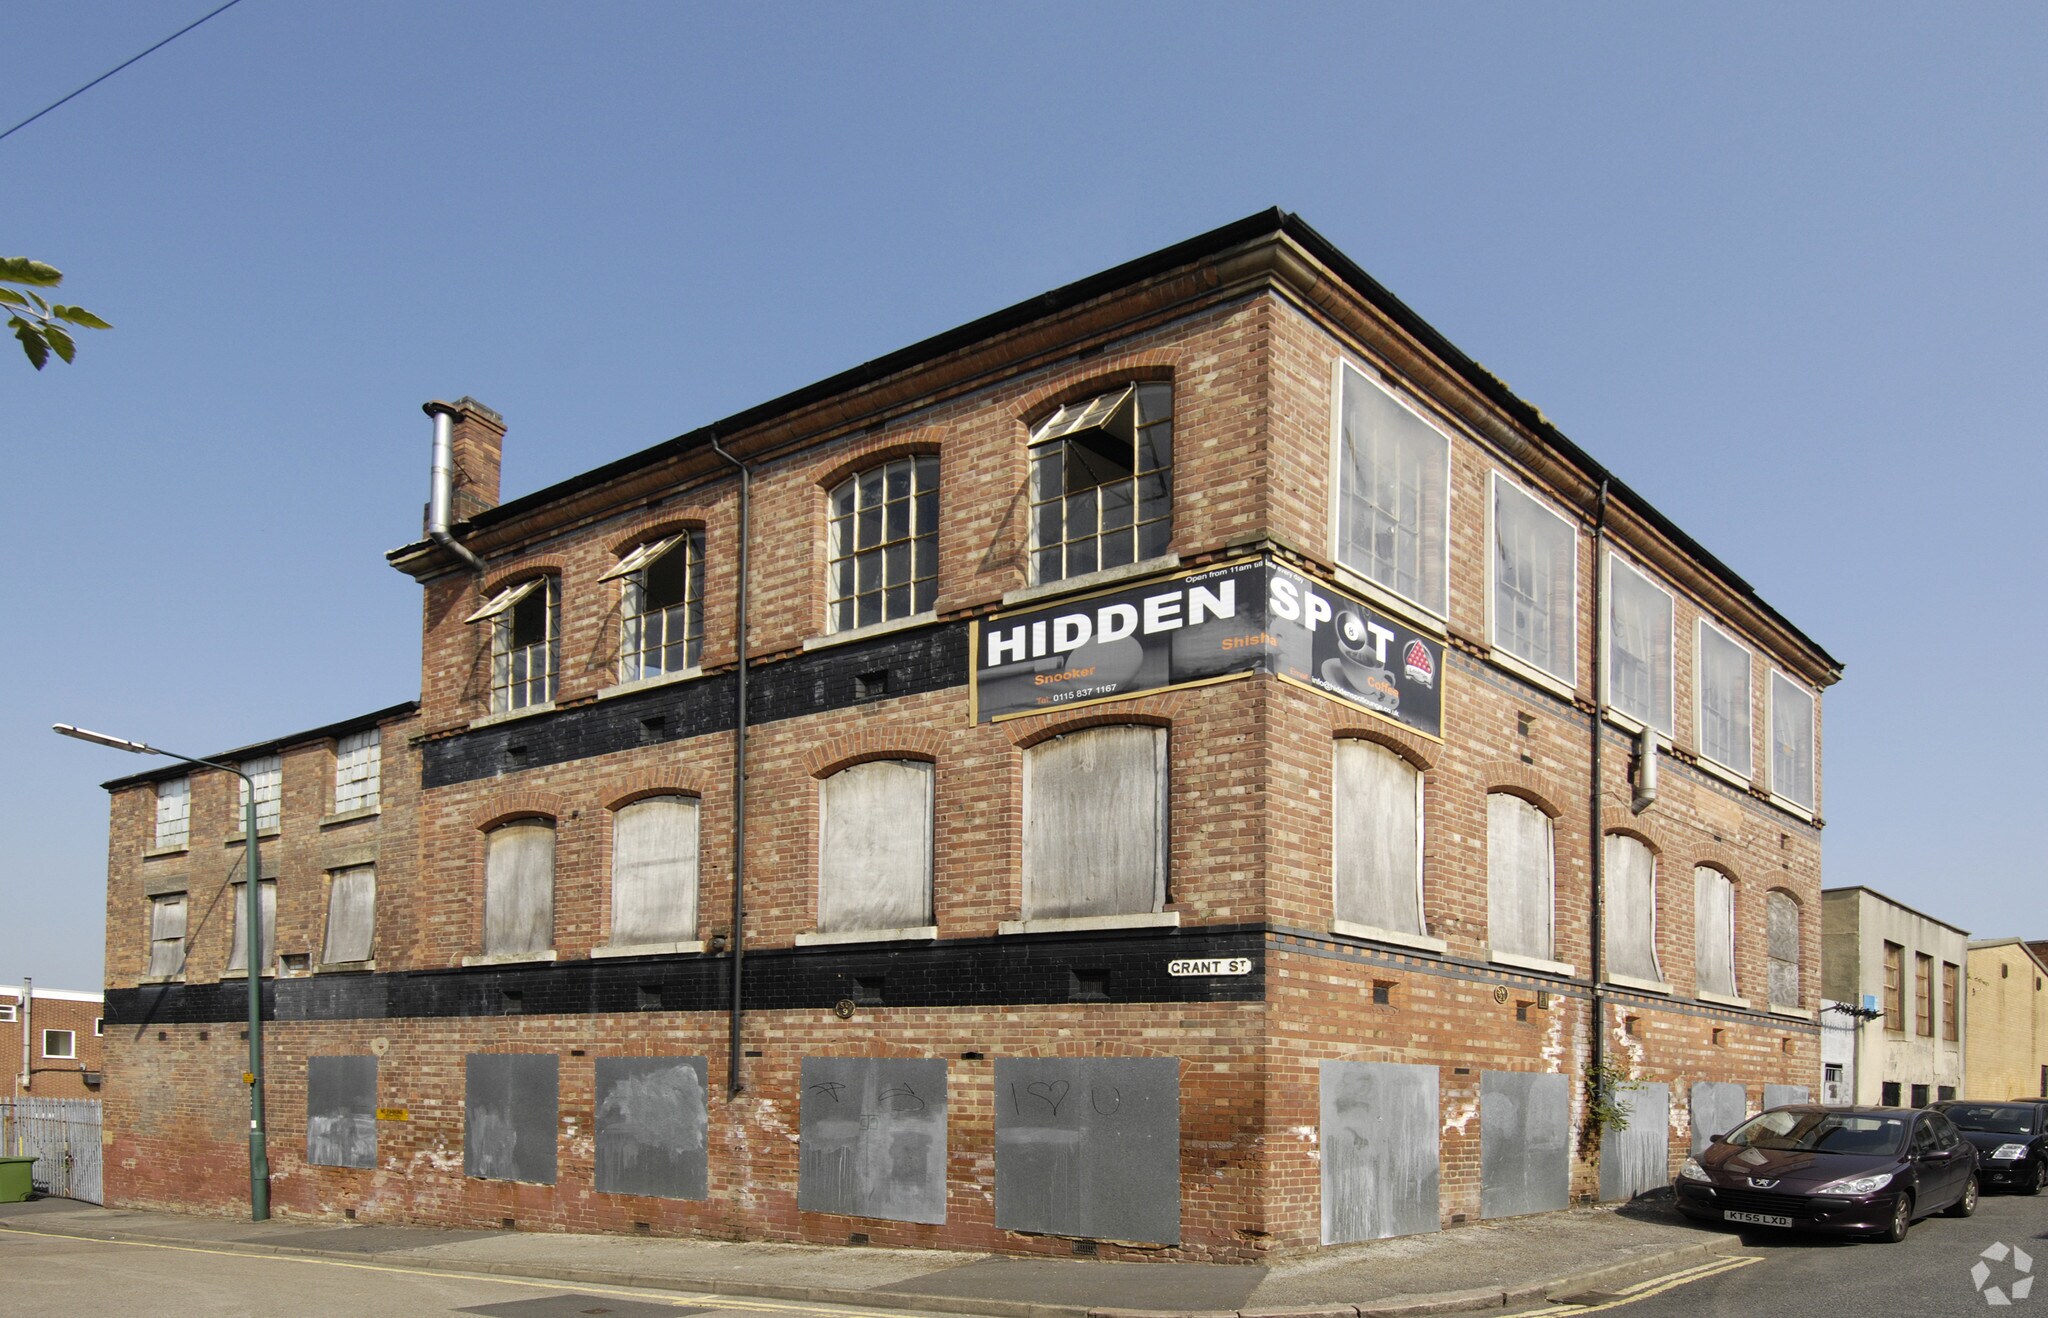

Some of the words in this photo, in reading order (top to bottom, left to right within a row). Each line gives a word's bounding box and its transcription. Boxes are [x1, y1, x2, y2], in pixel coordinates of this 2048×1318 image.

[1185, 572, 1208, 584] Open
[1209, 569, 1228, 578] from
[1230, 563, 1252, 573] 11am
[1253, 560, 1264, 570] till
[1265, 558, 1277, 570] late
[1277, 566, 1294, 579] every
[1293, 574, 1305, 584] day
[987, 578, 1236, 668] HIDDEN
[1221, 630, 1279, 651] Shisha
[1034, 666, 1096, 686] Snooker
[1367, 675, 1399, 697] Coffee
[1053, 691, 1075, 702] 0115
[1076, 687, 1093, 699] 837
[1095, 683, 1117, 695] 1167
[1171, 961, 1221, 974] GRANT
[1729, 1211, 1760, 1222] KT55
[1762, 1215, 1787, 1225] LXD
